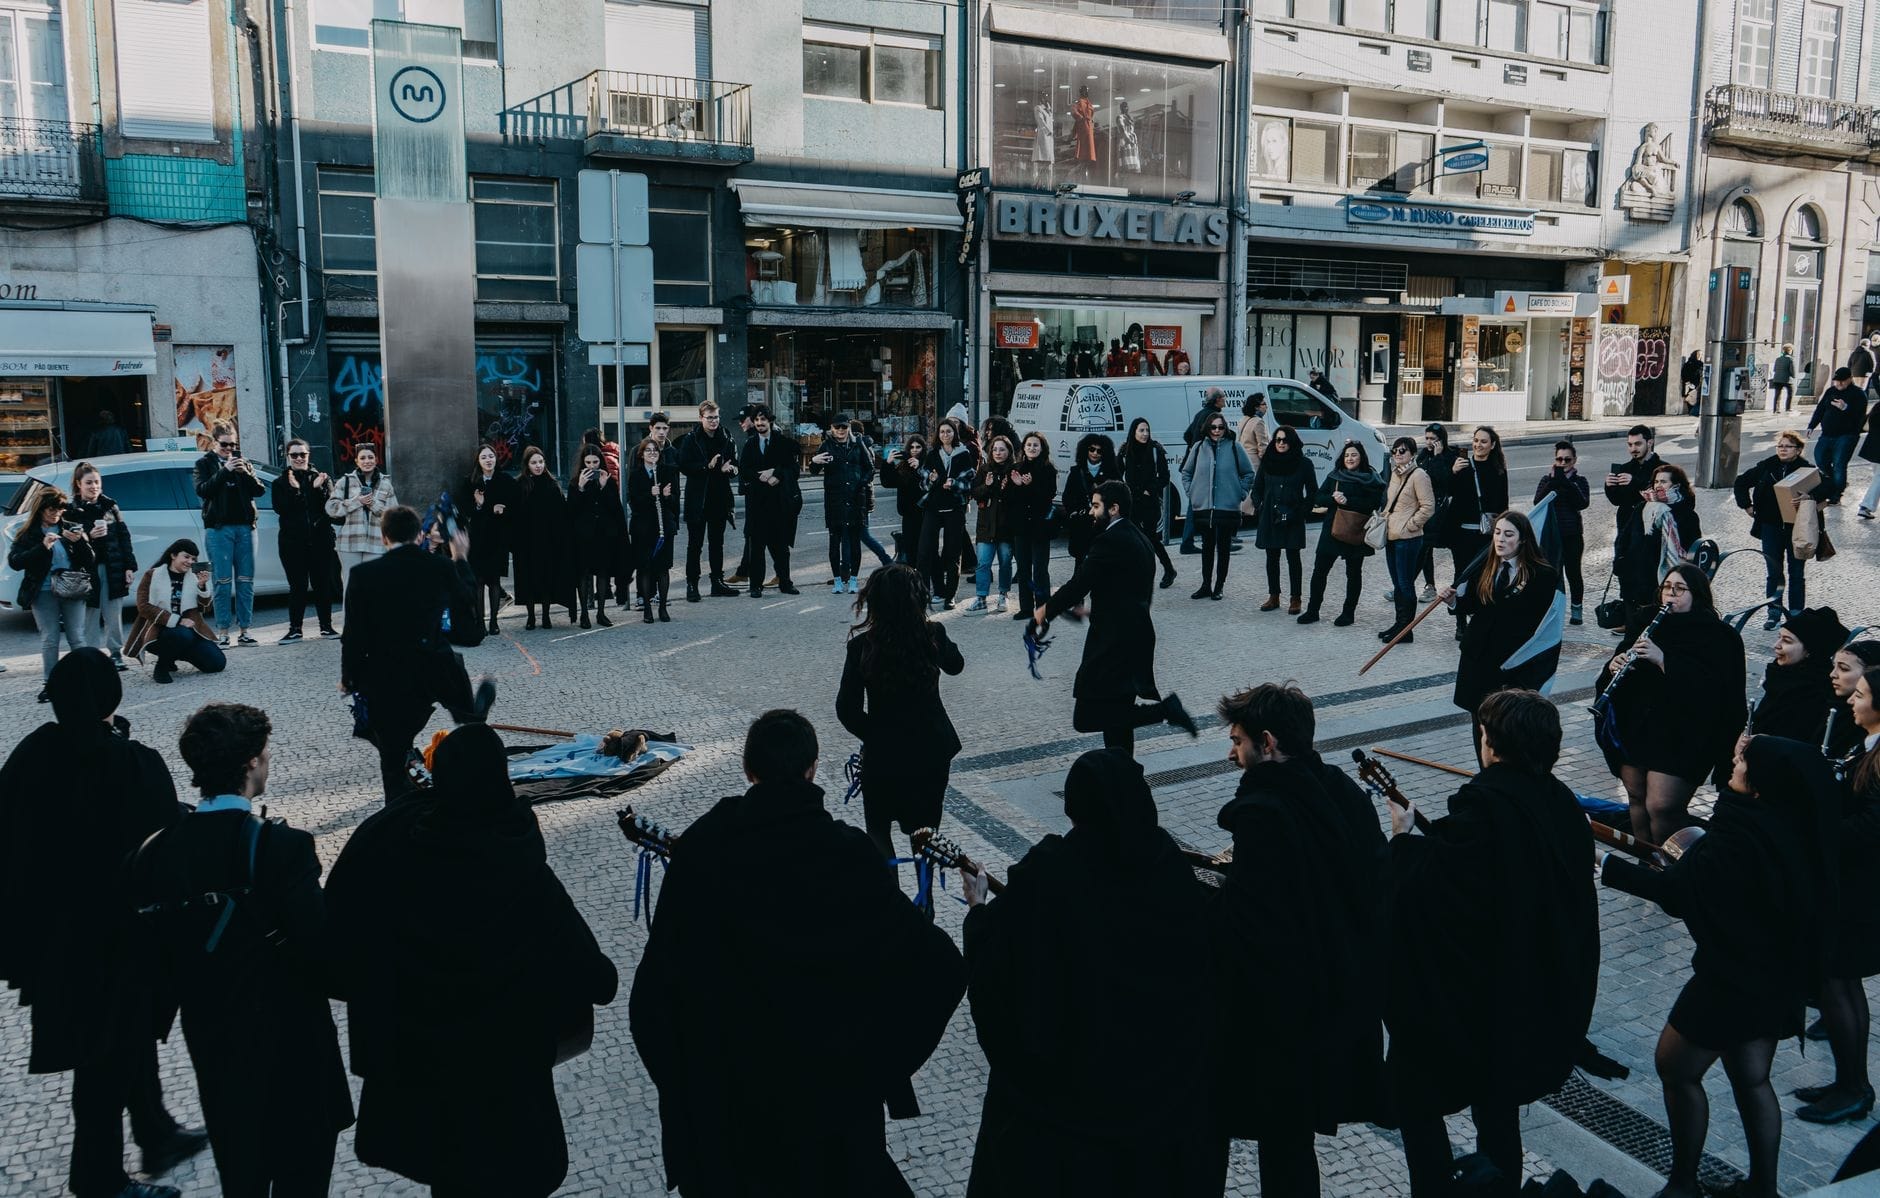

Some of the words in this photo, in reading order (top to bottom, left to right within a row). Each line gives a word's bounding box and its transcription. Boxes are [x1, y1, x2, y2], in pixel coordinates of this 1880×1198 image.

[999, 199, 1229, 246] BRUXELAS
[1409, 208, 1454, 225] RUSSO
[1457, 215, 1533, 231] CABELEIREIROS
[1005, 335, 1030, 344] SALDOS
[1151, 338, 1174, 346] SALDOS
[1298, 348, 1345, 368] AMOR
[1076, 392, 1107, 405] Leitão
[1078, 404, 1091, 414] do
[1093, 403, 1106, 413] Zé
